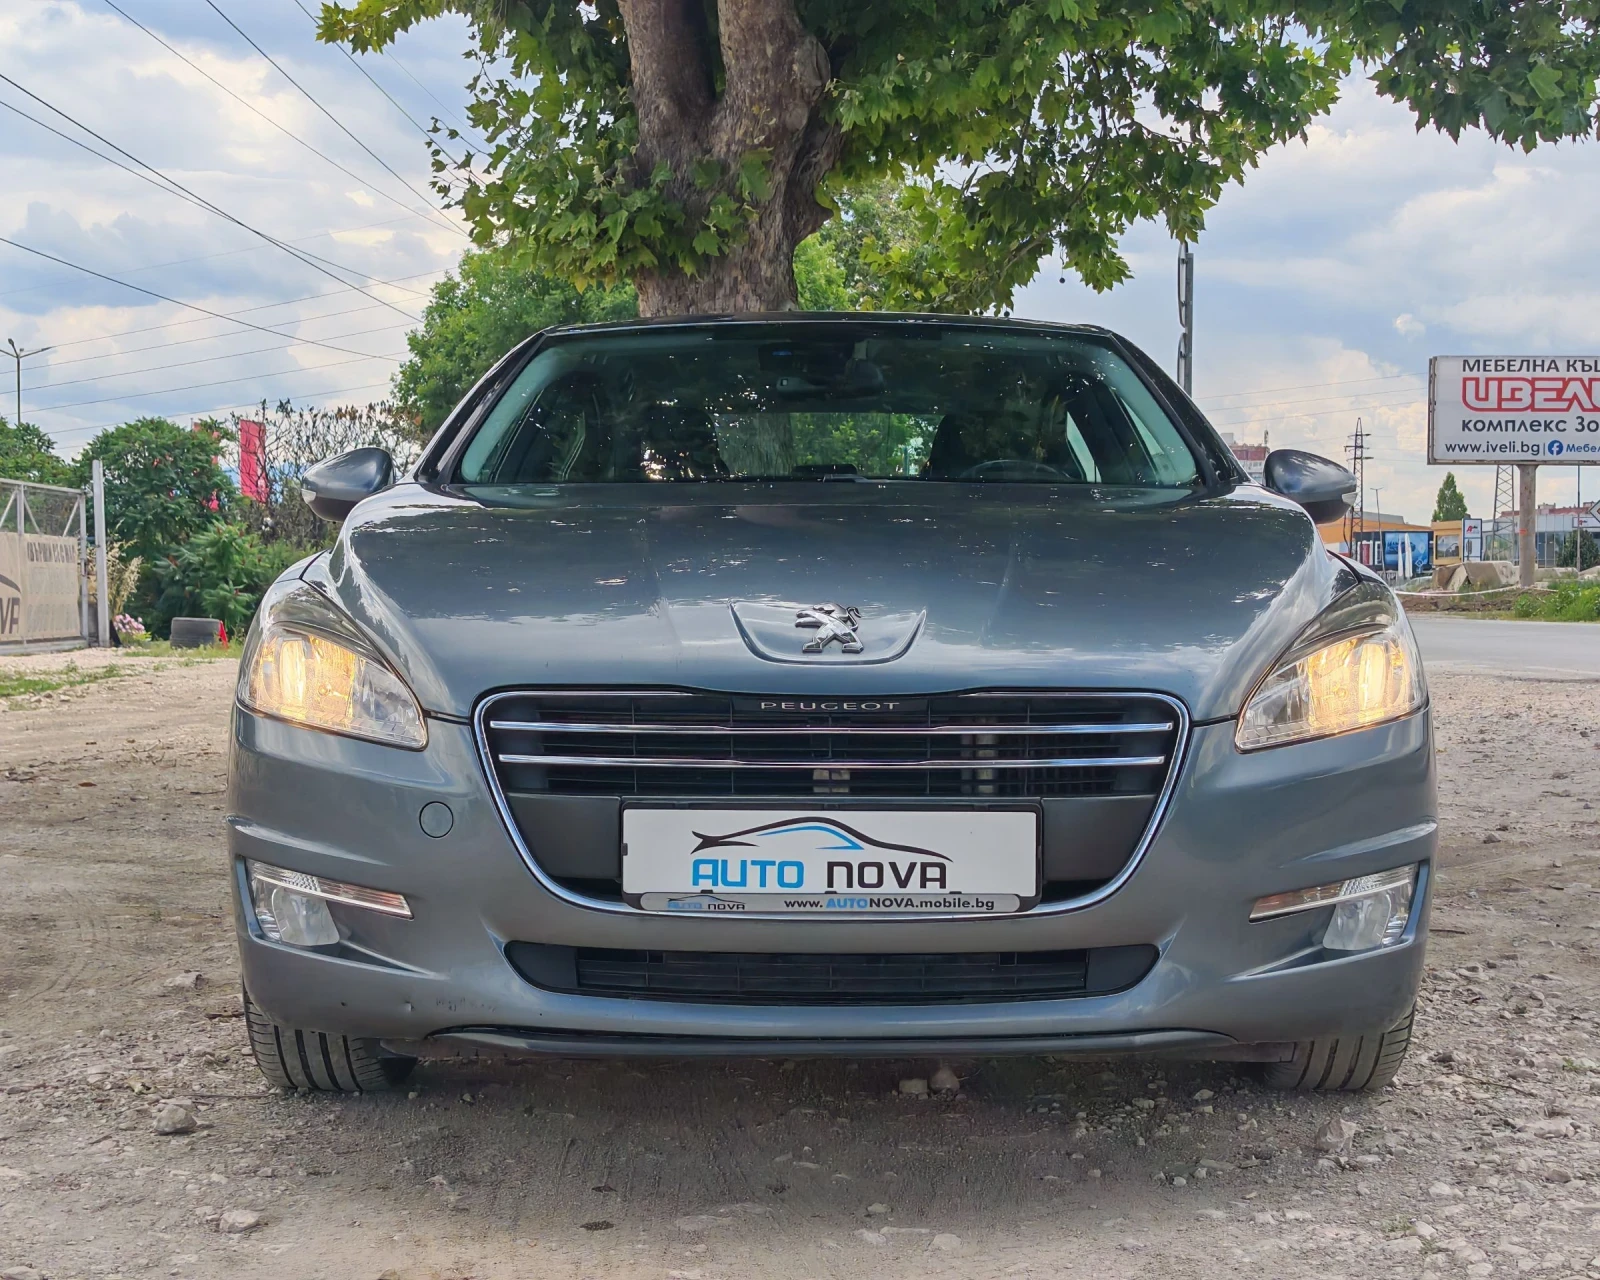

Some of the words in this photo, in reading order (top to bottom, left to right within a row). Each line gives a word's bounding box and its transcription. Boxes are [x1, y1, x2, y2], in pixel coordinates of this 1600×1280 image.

[1462, 359, 1559, 372] МЕБЕЛНА
[1461, 419, 1567, 432] комплекс
[1445, 441, 1540, 455] www.iveli.bg
[760, 702, 900, 710] PEUGEOT
[692, 858, 805, 888] AUTO
[827, 861, 947, 889] NOVA
[707, 902, 745, 911] NOVA
